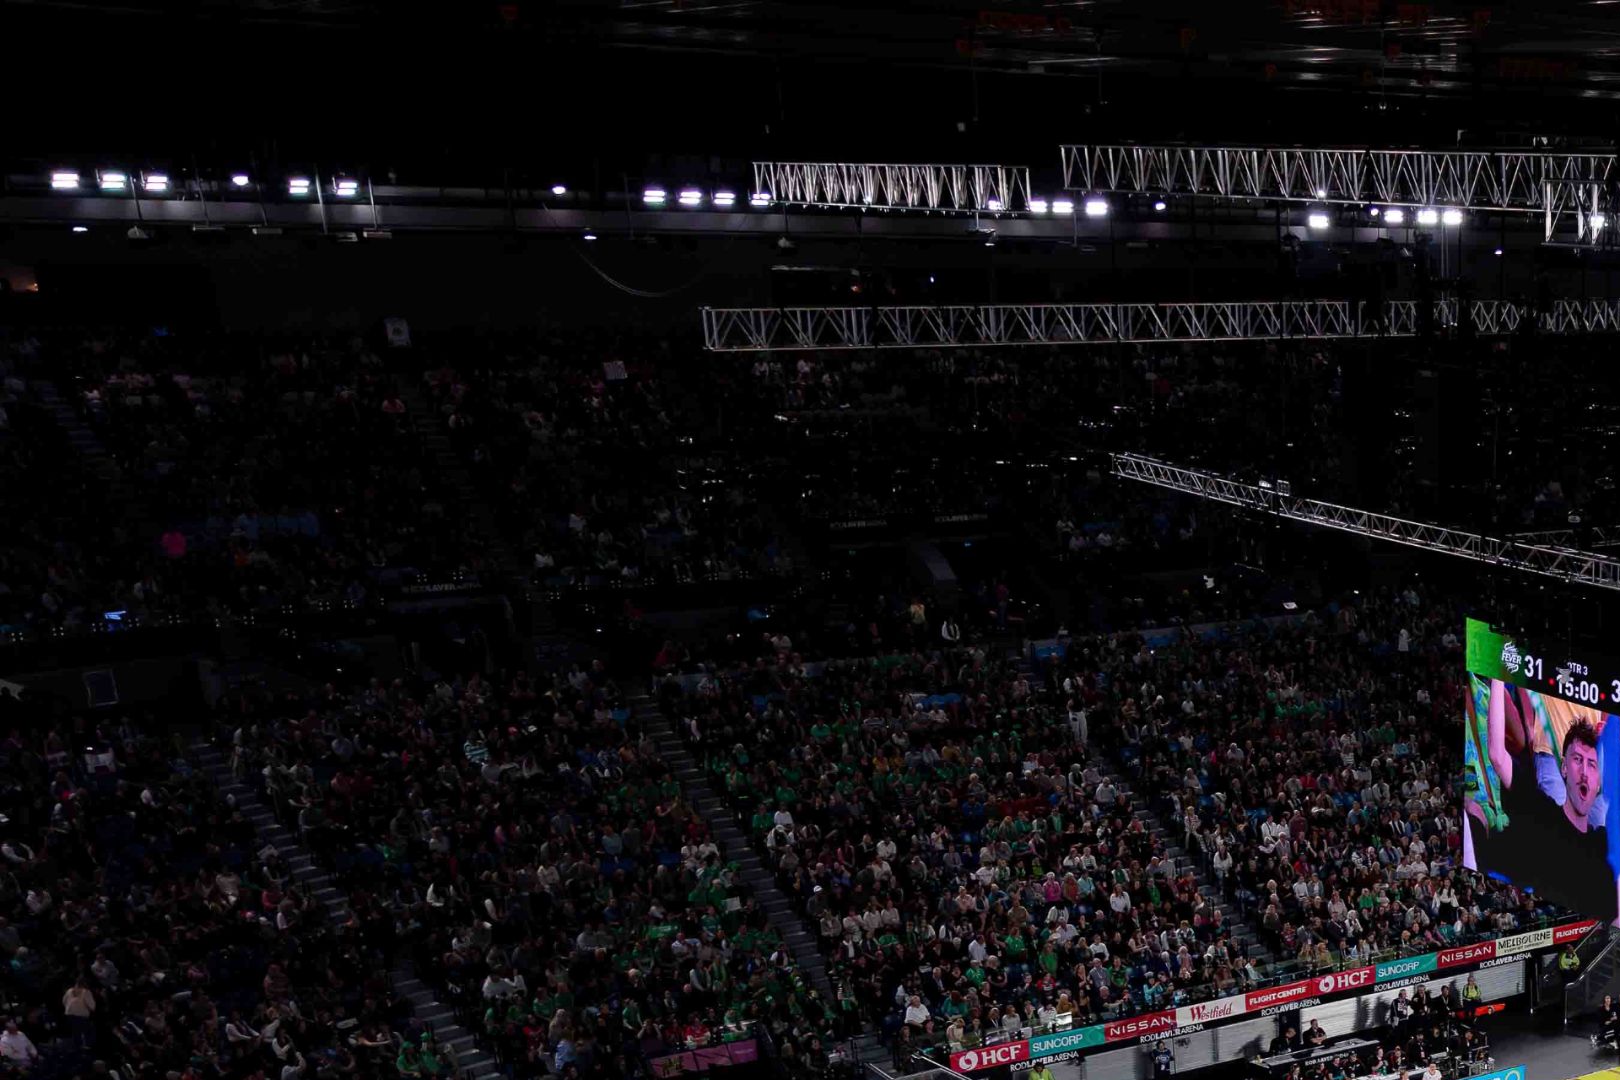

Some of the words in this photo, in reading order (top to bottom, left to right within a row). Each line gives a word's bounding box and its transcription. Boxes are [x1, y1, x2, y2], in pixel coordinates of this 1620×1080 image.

[1524, 655, 1543, 680] 31
[1557, 675, 1599, 704] 15:00
[1499, 930, 1552, 950] MELBOURNE
[1441, 946, 1492, 963] NISSAN
[1336, 970, 1370, 989] HCF
[1378, 961, 1420, 978] SUNCORP
[1249, 992, 1276, 1006] FLIGHT
[1277, 986, 1306, 1000] CENTRE
[1190, 1003, 1232, 1022] Westfield
[1110, 1016, 1172, 1036] NISSAN
[1032, 1034, 1083, 1053] SUNCORP
[981, 1046, 1022, 1066] HCF
